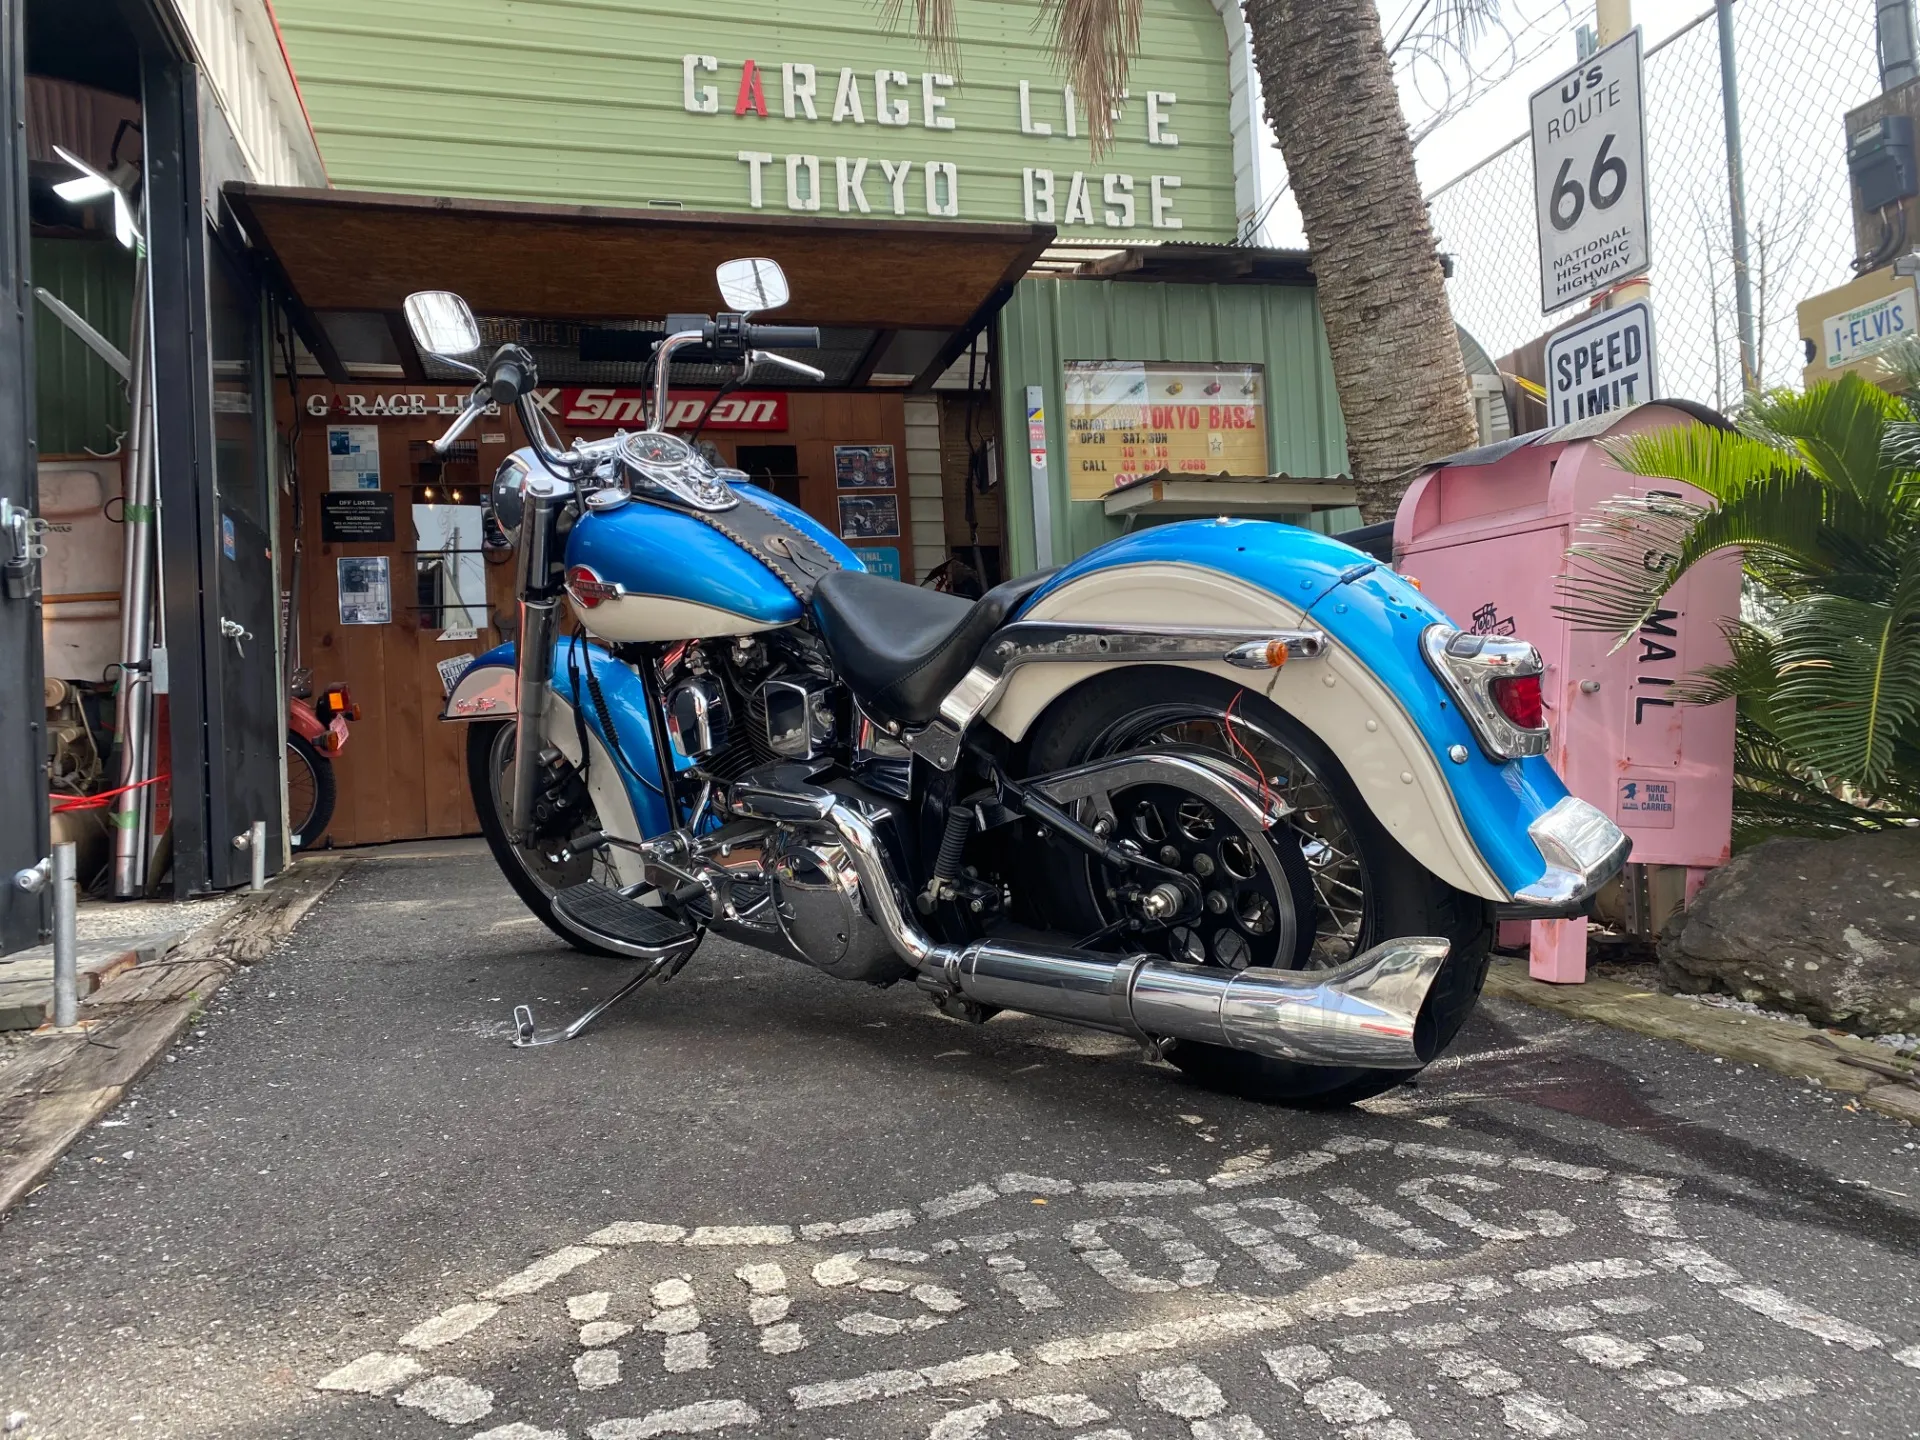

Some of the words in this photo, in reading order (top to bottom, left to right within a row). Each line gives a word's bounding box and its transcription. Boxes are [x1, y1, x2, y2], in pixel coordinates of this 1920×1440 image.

[683, 54, 955, 130] GARAGE
[1547, 78, 1621, 144] ROUTE
[737, 150, 958, 217] TOKYO
[1022, 167, 1183, 229] BASE
[1550, 134, 1628, 232] 66
[1553, 226, 1631, 270] NATIONAL
[1557, 240, 1629, 281] HISTORIC
[1557, 253, 1631, 295] HIGHWAY
[1557, 324, 1642, 392] SPEED
[306, 394, 428, 416] GARAGE
[436, 395, 501, 416] LIE
[1141, 404, 1200, 429] TOKYO
[1208, 404, 1256, 429] BASE
[1081, 432, 1106, 444] OPEN
[1082, 460, 1108, 471] CALL
[1634, 608, 1679, 727] MAIL
[1641, 802, 1672, 811] CARRIER
[1646, 784, 1669, 793] RURAL
[1648, 793, 1666, 802] MAIL
[562, 1172, 1579, 1391] HISTORIC
